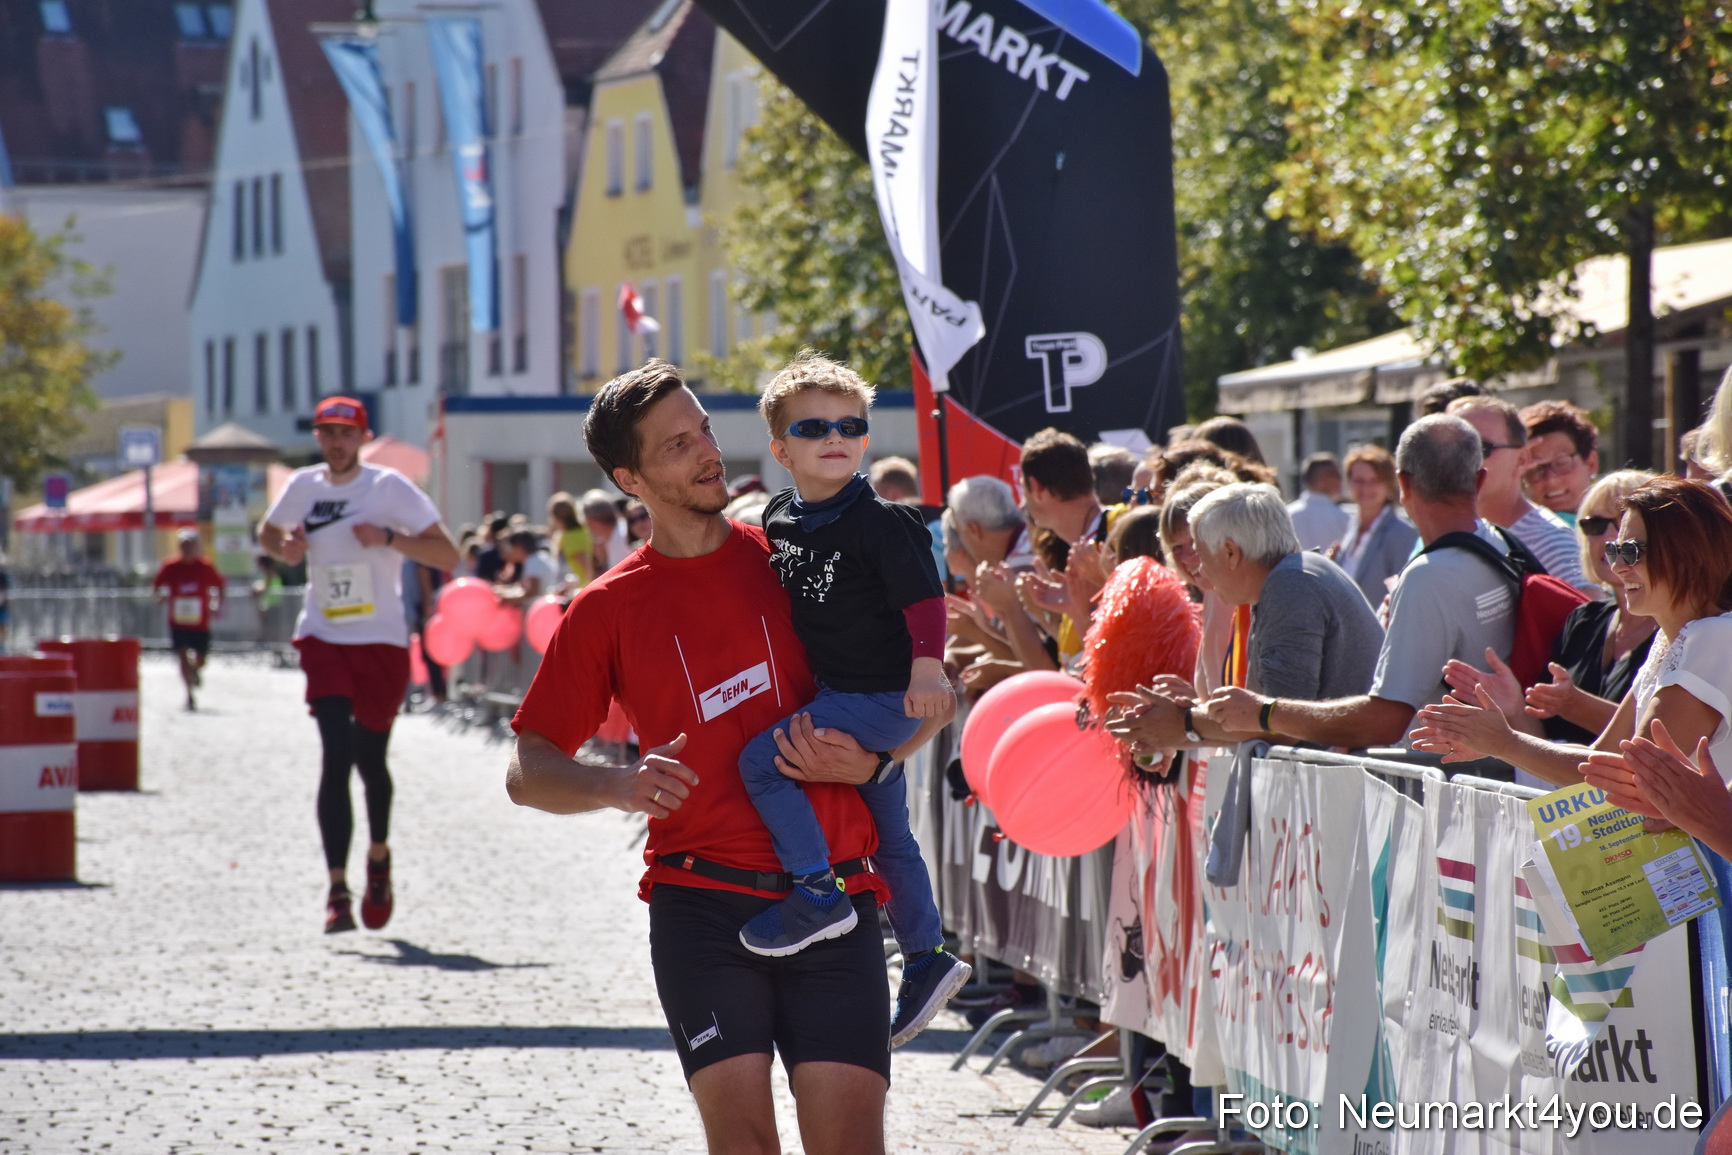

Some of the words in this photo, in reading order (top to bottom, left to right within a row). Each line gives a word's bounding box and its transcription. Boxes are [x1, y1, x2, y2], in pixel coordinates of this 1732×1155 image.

[329, 582, 351, 599] 37
[722, 678, 748, 703] DEHN
[1538, 788, 1612, 824] URKU
[1549, 823, 1592, 852] 19.
[1592, 814, 1650, 840] Stadtlau
[1608, 832, 1642, 849] September
[1604, 850, 1627, 864] DKMS
[1581, 883, 1605, 896] Thomas
[1605, 874, 1632, 888] Assmann
